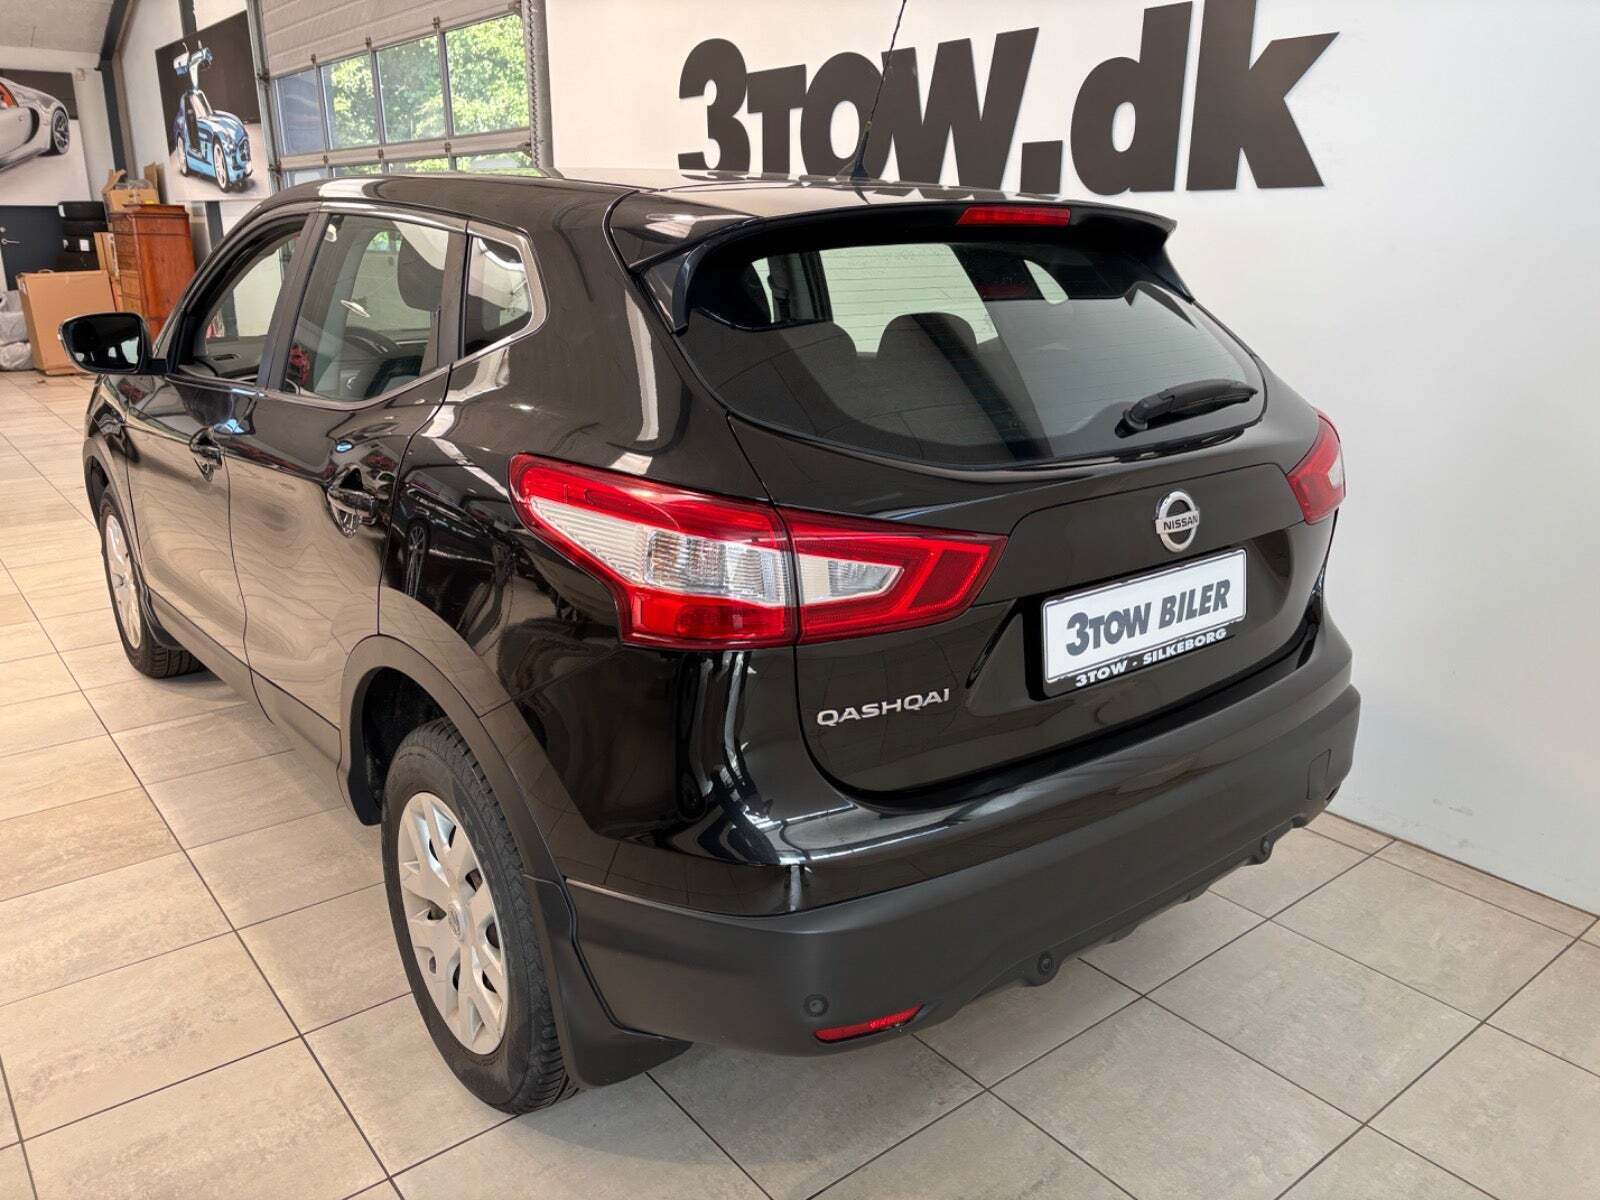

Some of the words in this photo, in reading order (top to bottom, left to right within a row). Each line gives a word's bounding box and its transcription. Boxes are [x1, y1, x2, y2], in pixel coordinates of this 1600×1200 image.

[678, 0, 1340, 196] 3TOW.dk
[1163, 515, 1199, 532] NISSAN
[1066, 602, 1152, 656] 3TOW
[1158, 579, 1231, 629] BILER
[1075, 659, 1127, 687] 3TOW
[1142, 628, 1227, 665] SILKEBORG
[816, 688, 950, 726] QASHQAI
